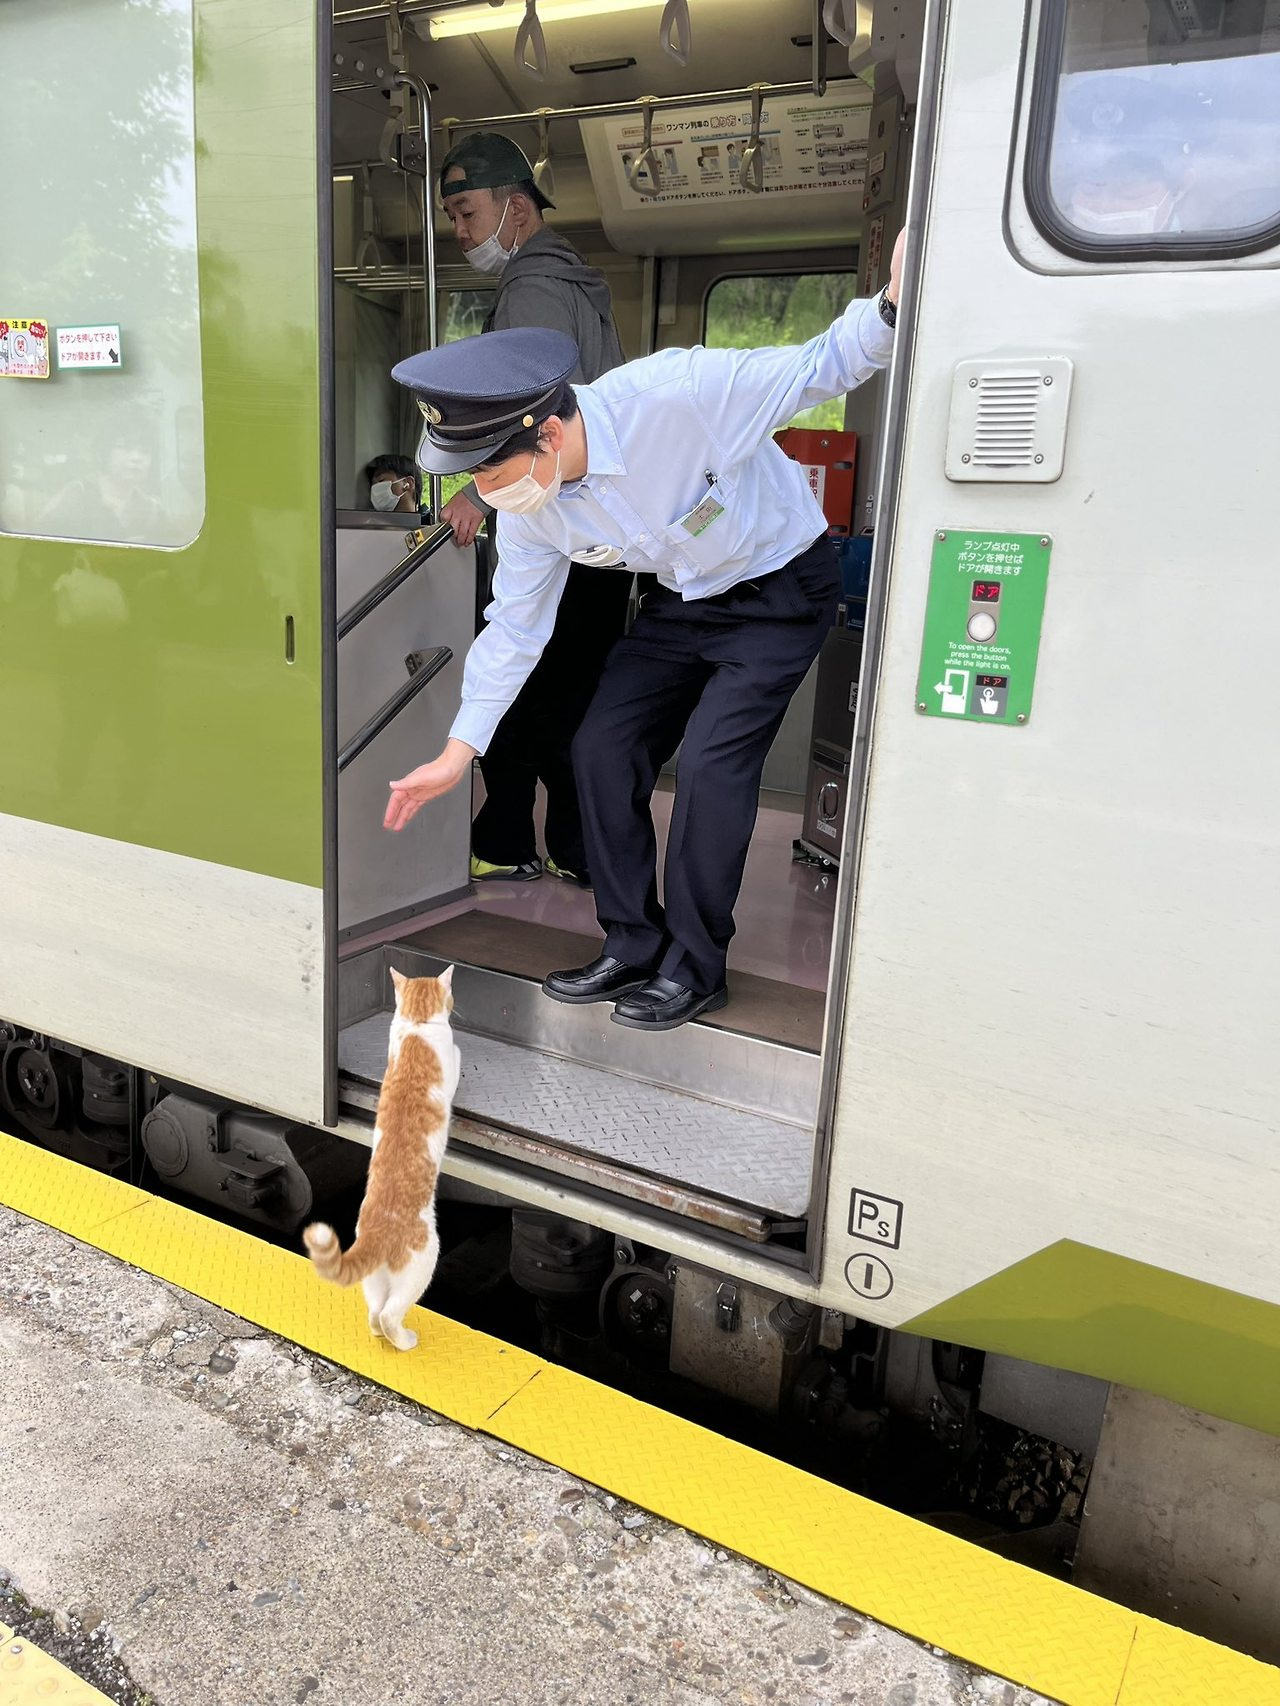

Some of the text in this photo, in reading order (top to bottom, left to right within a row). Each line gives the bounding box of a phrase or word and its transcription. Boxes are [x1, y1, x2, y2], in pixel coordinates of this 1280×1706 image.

[666, 111, 769, 131] ワンマン列車の乗り方・降方
[12, 320, 27, 329] 注意
[59, 332, 117, 344] ボタンを押して下さい
[964, 540, 1020, 551] ランプ点灯中
[957, 552, 1024, 564] ボタンを押せば
[957, 563, 1022, 576] ドアが開きます
[975, 585, 1000, 598] ドア
[949, 641, 957, 649] To
[958, 644, 975, 652] open
[950, 651, 970, 659] press
[983, 653, 1007, 661] button
[944, 658, 962, 666] while
[975, 660, 991, 669] light
[992, 661, 999, 669] is
[983, 676, 1002, 685] ドア
[858, 1199, 890, 1237] Ps
